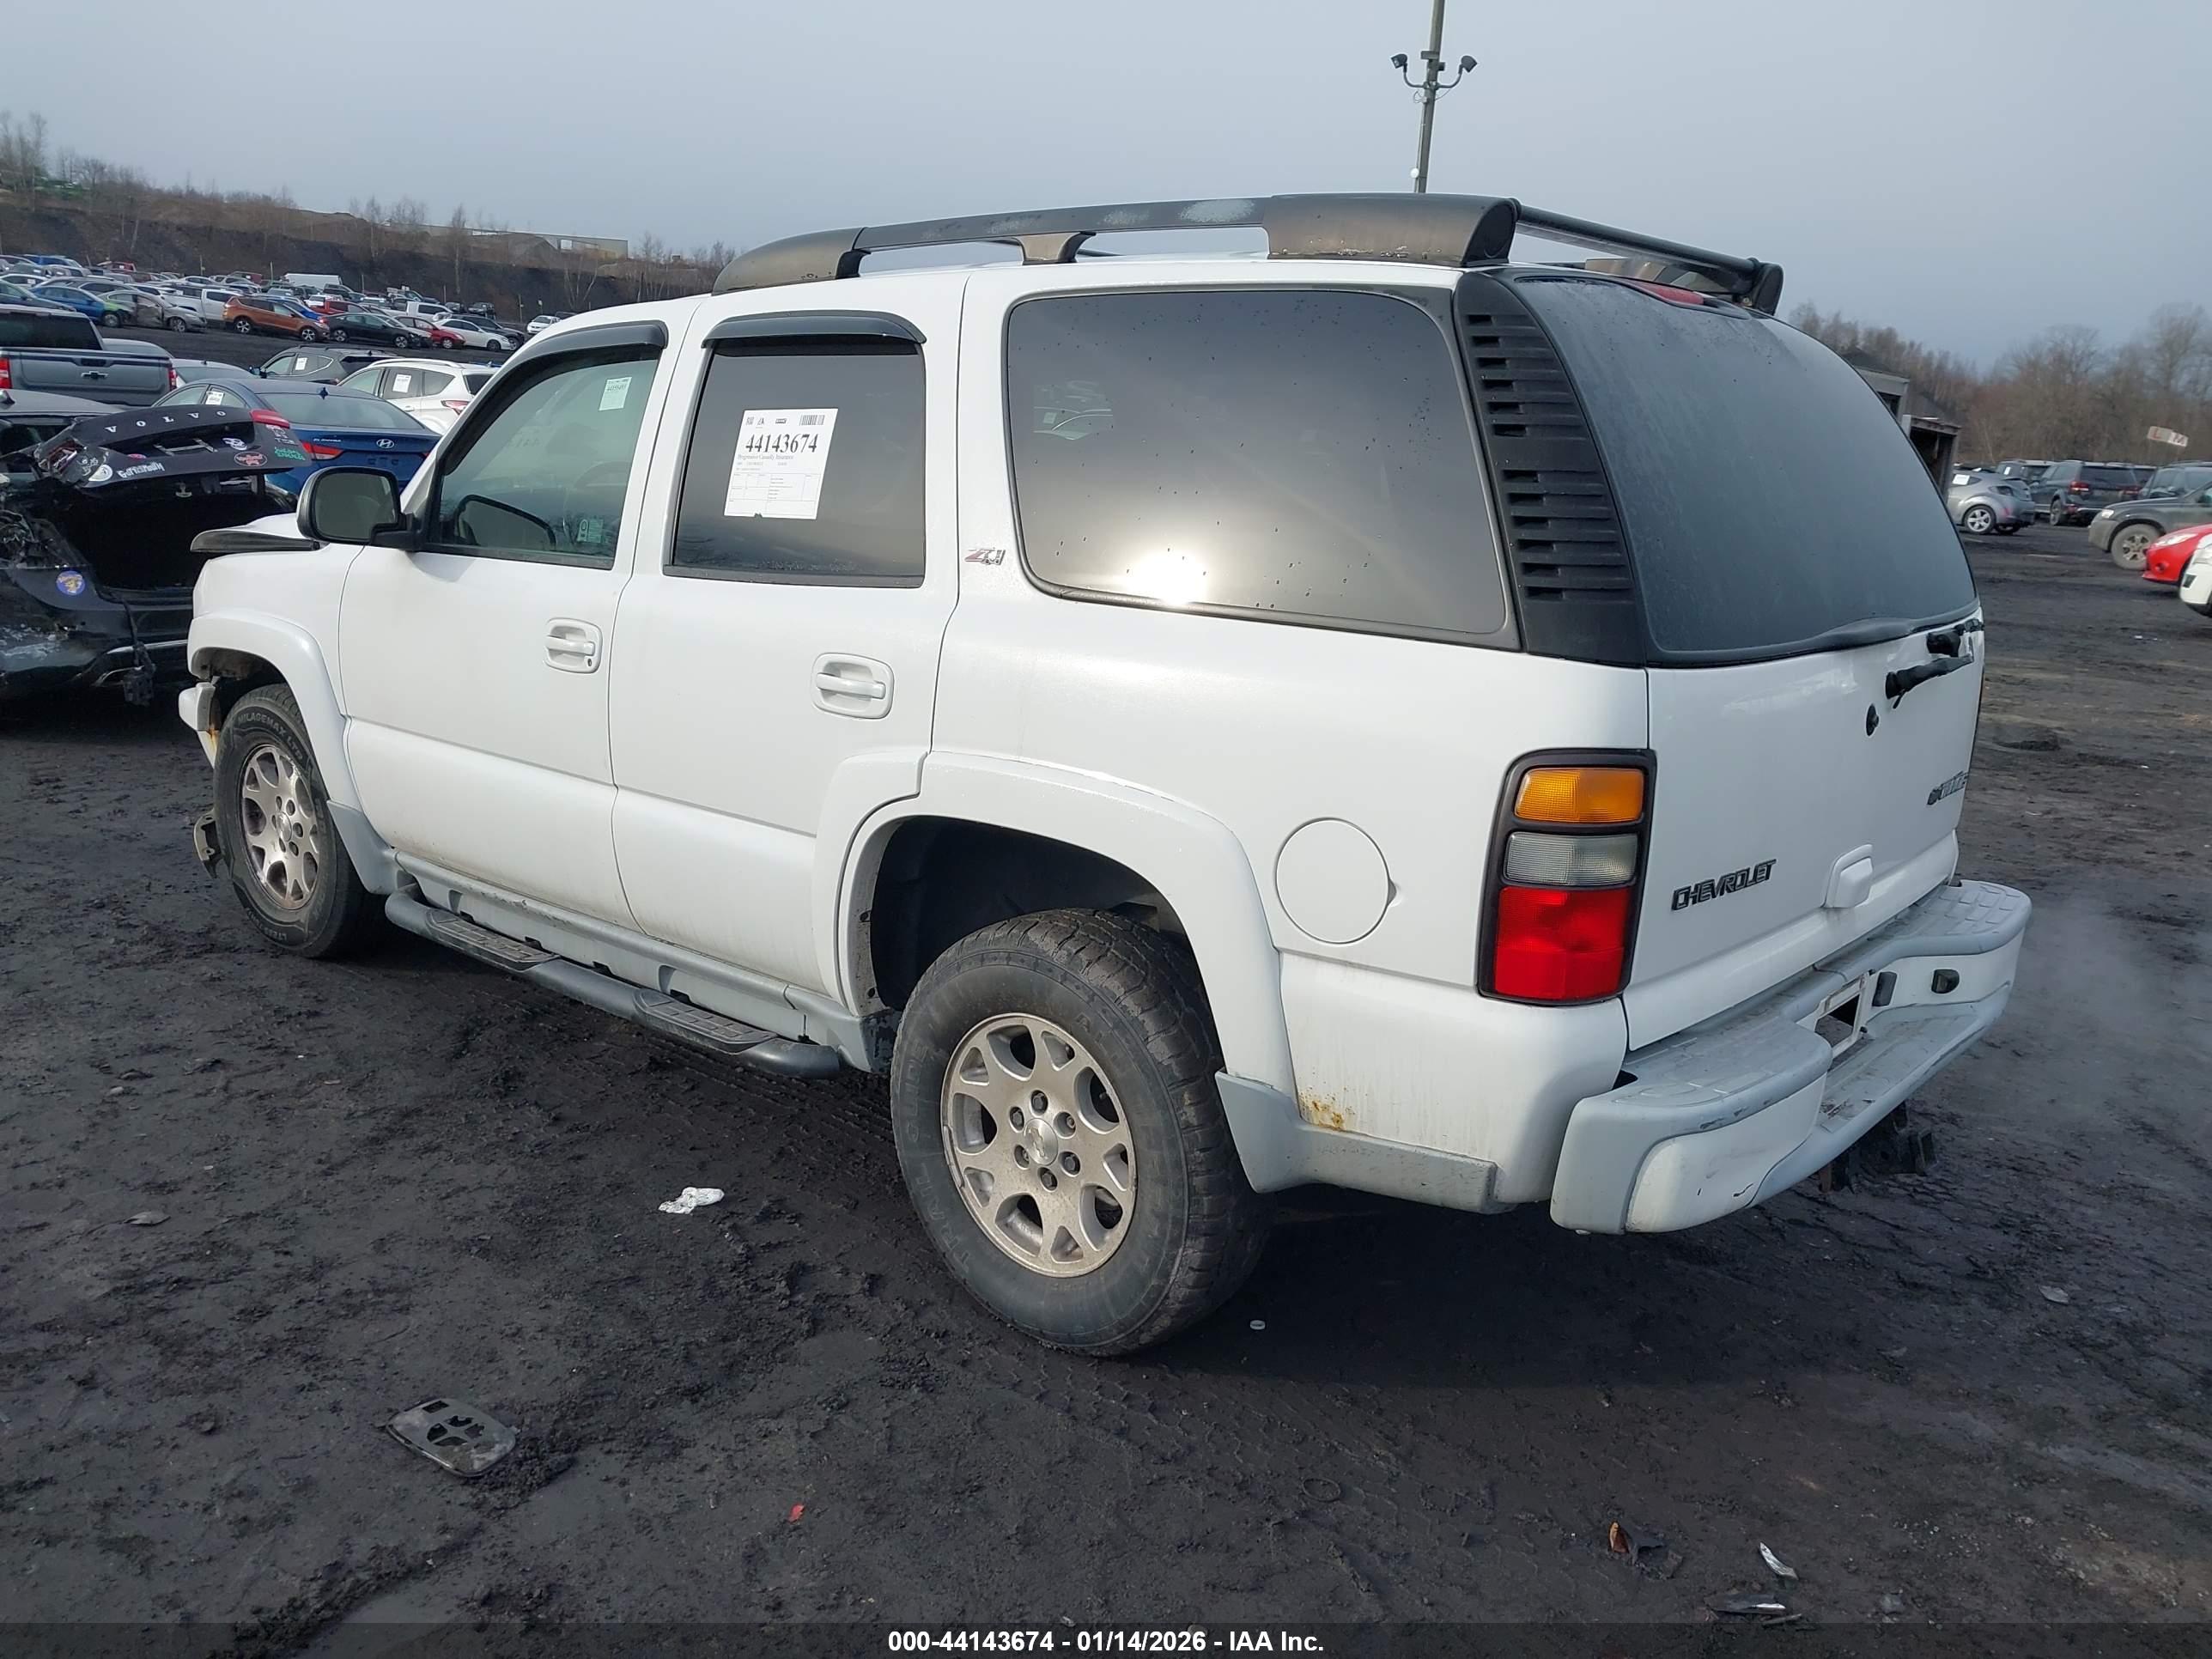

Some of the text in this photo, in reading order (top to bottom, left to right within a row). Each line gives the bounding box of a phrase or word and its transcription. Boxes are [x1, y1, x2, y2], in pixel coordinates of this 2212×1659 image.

[105, 410, 227, 433] VOLVO
[745, 434, 818, 453] 44143674
[964, 549, 1006, 566] Z71
[1671, 859, 1778, 912] CHEVROLET
